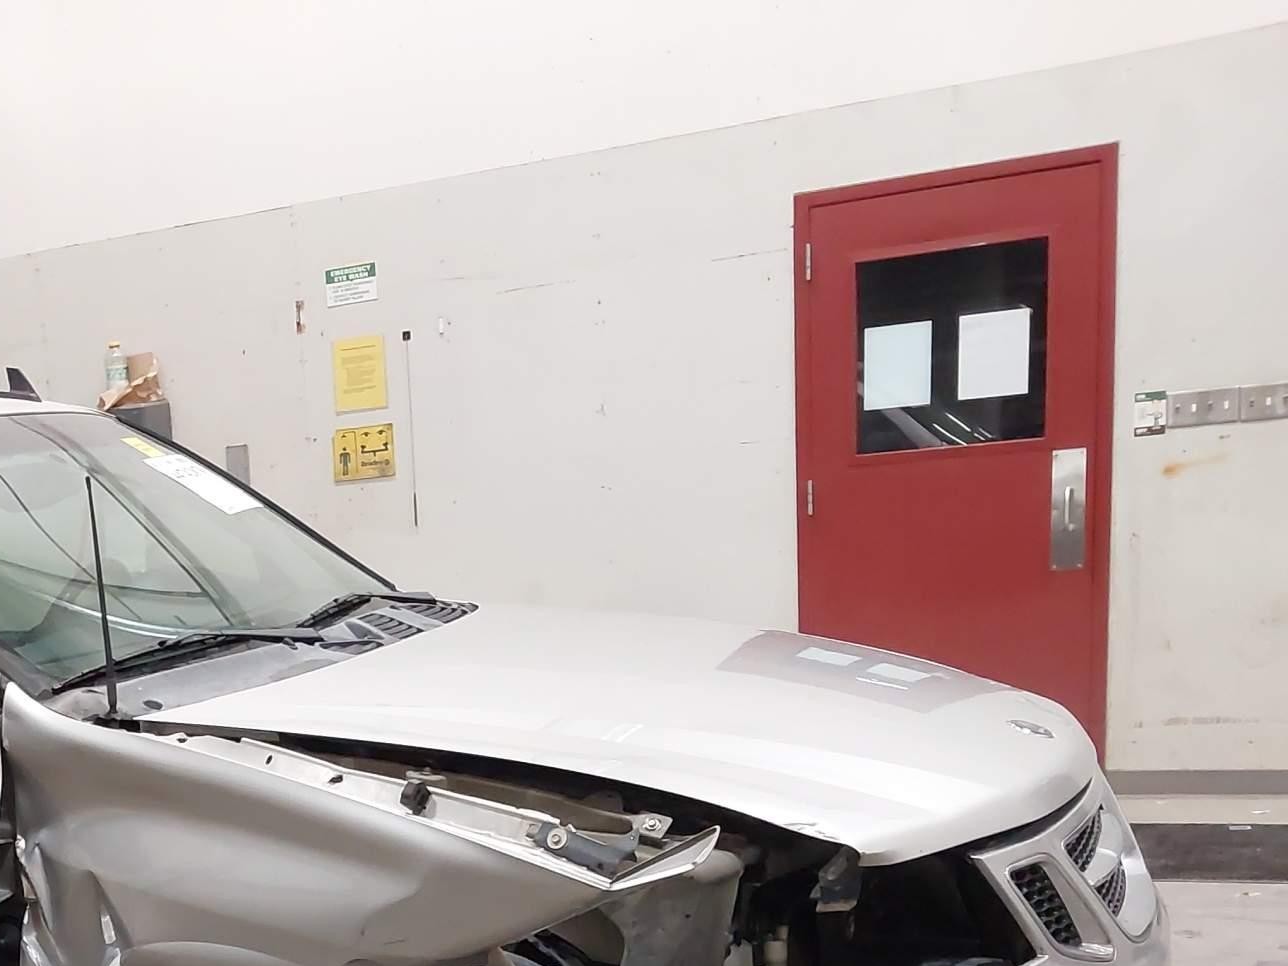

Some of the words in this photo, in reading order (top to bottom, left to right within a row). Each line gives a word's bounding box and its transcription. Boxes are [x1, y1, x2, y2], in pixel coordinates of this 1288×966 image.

[330, 265, 371, 277] EMERGENCY
[333, 275, 348, 283] EYE
[348, 271, 369, 280] WASH
